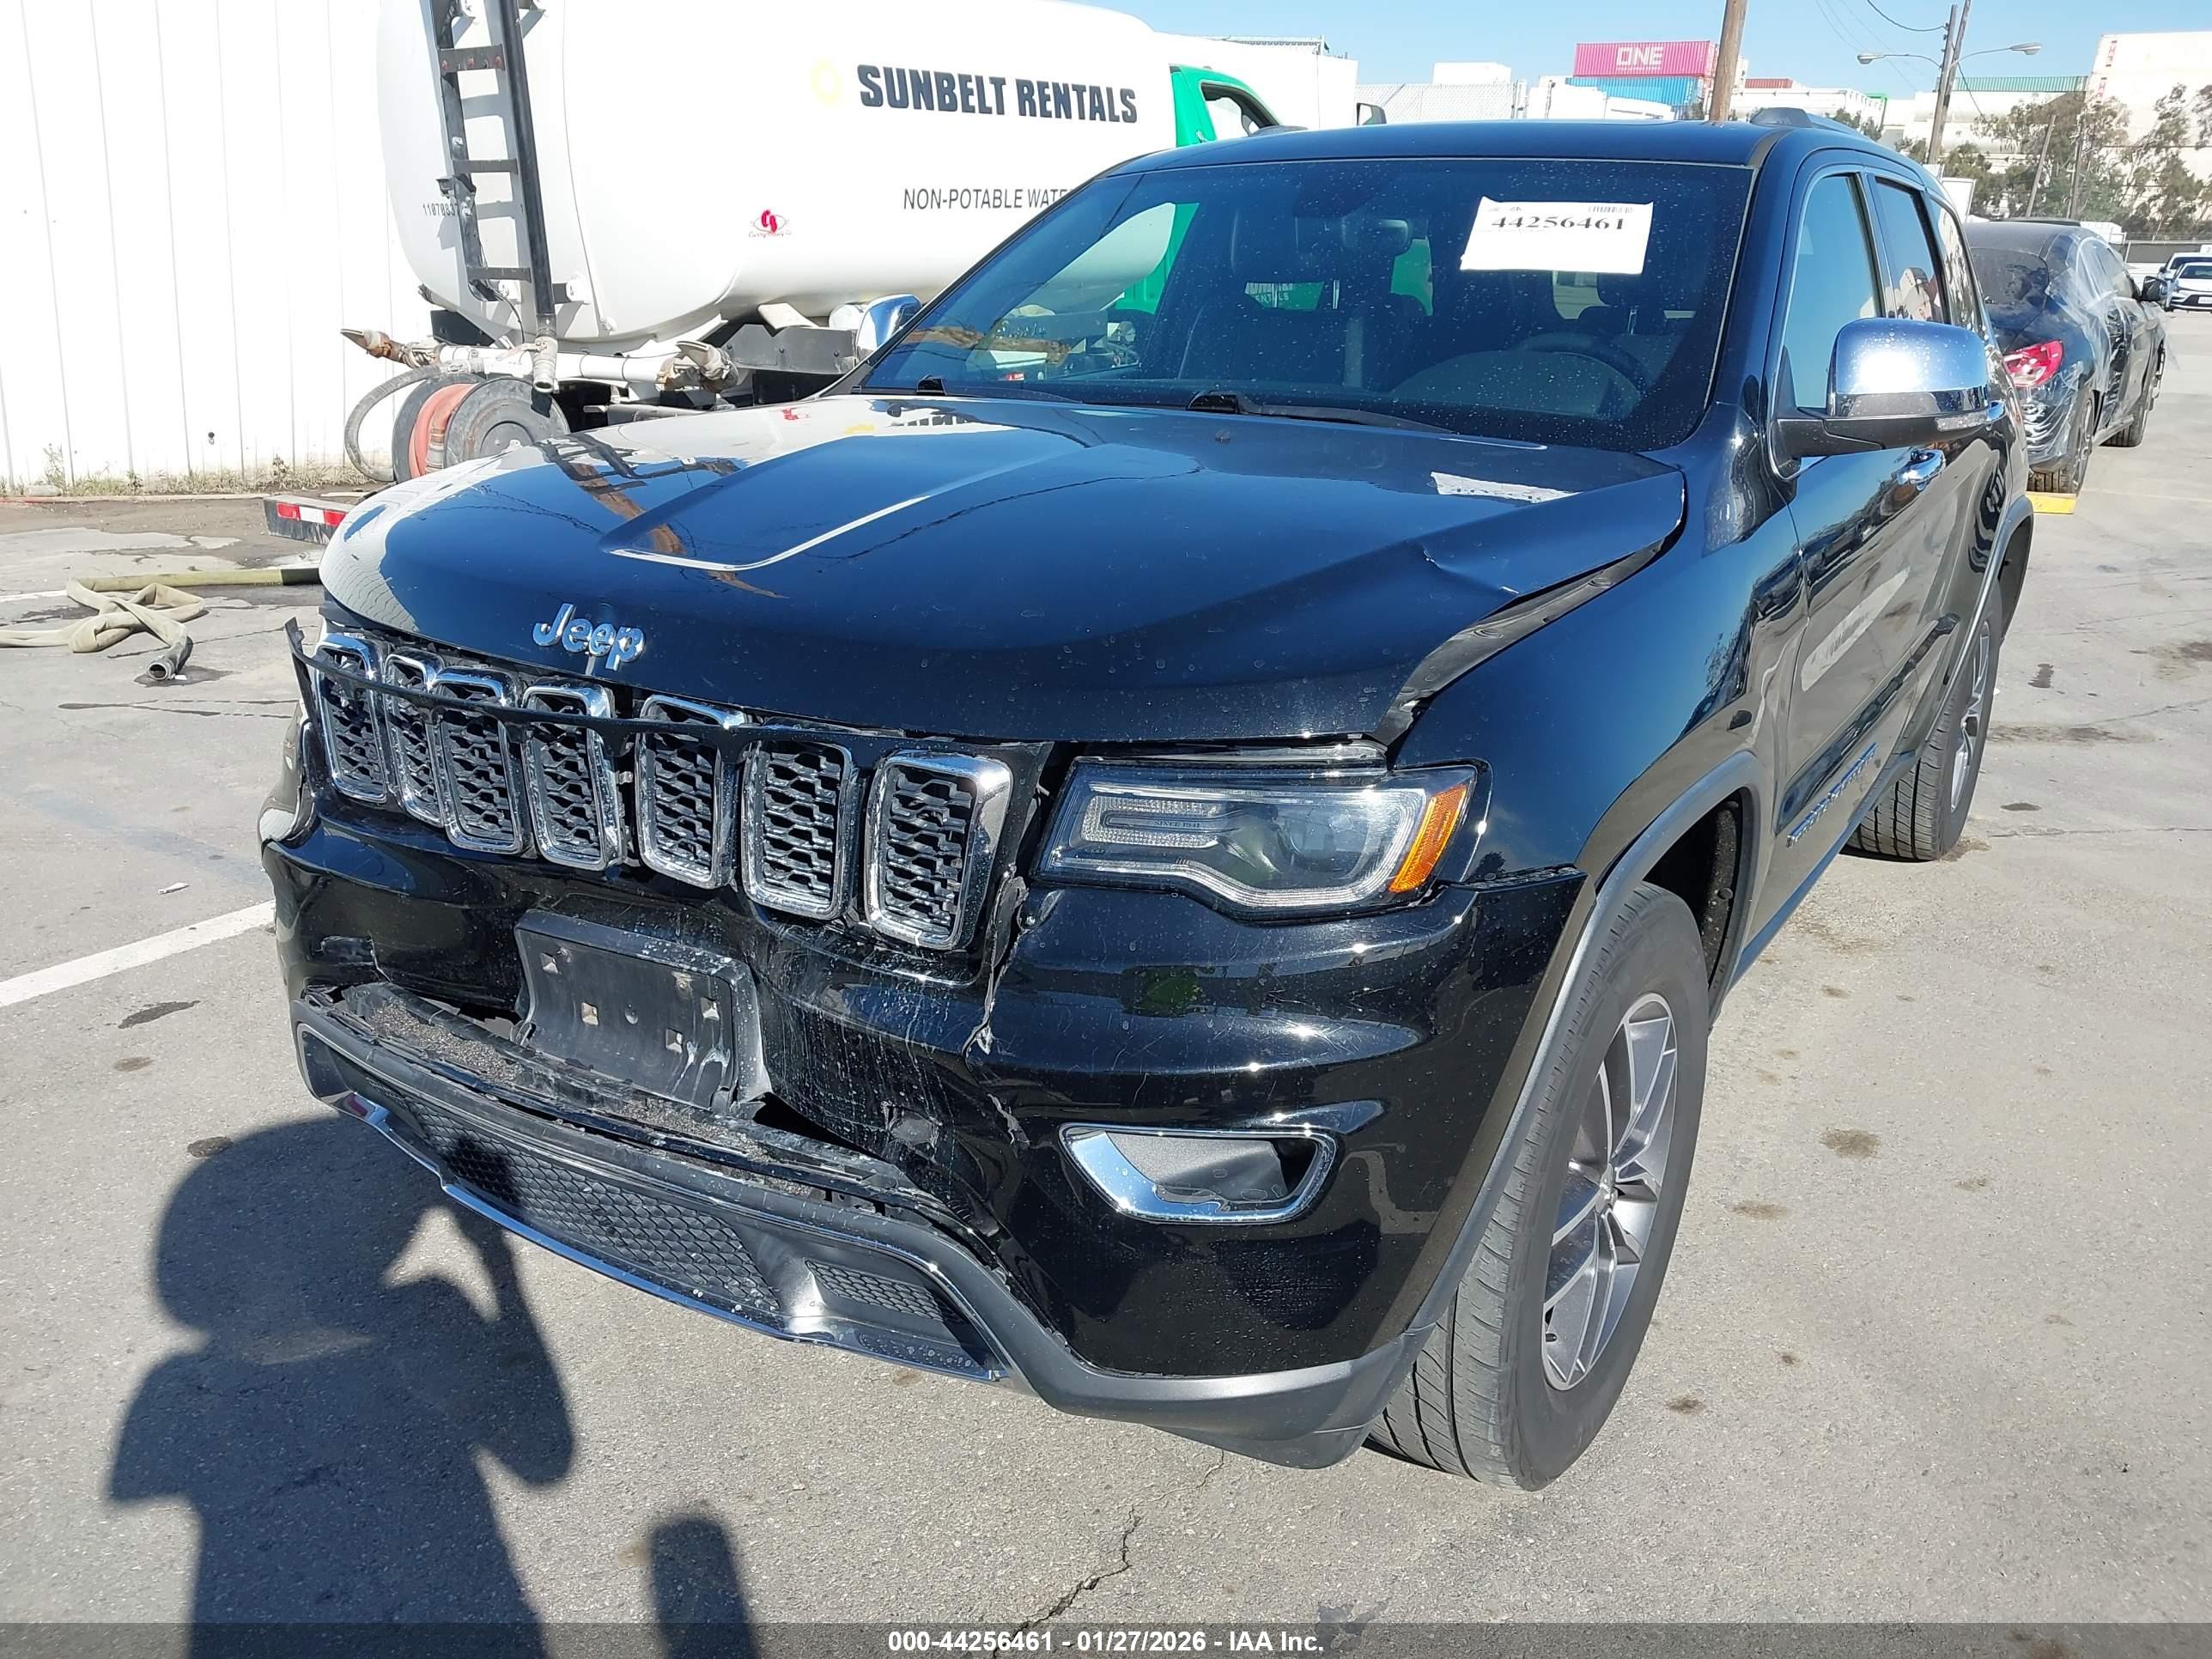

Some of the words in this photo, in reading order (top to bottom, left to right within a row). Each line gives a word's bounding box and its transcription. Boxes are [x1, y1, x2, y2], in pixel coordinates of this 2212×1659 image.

[1616, 46, 1663, 66] ONE
[857, 64, 1006, 115] SUNBELT
[1015, 78, 1138, 124] RENTALS
[903, 188, 1024, 210] NON-POTABLE
[1491, 216, 1625, 230] 44256461
[532, 603, 646, 672] Jeep
